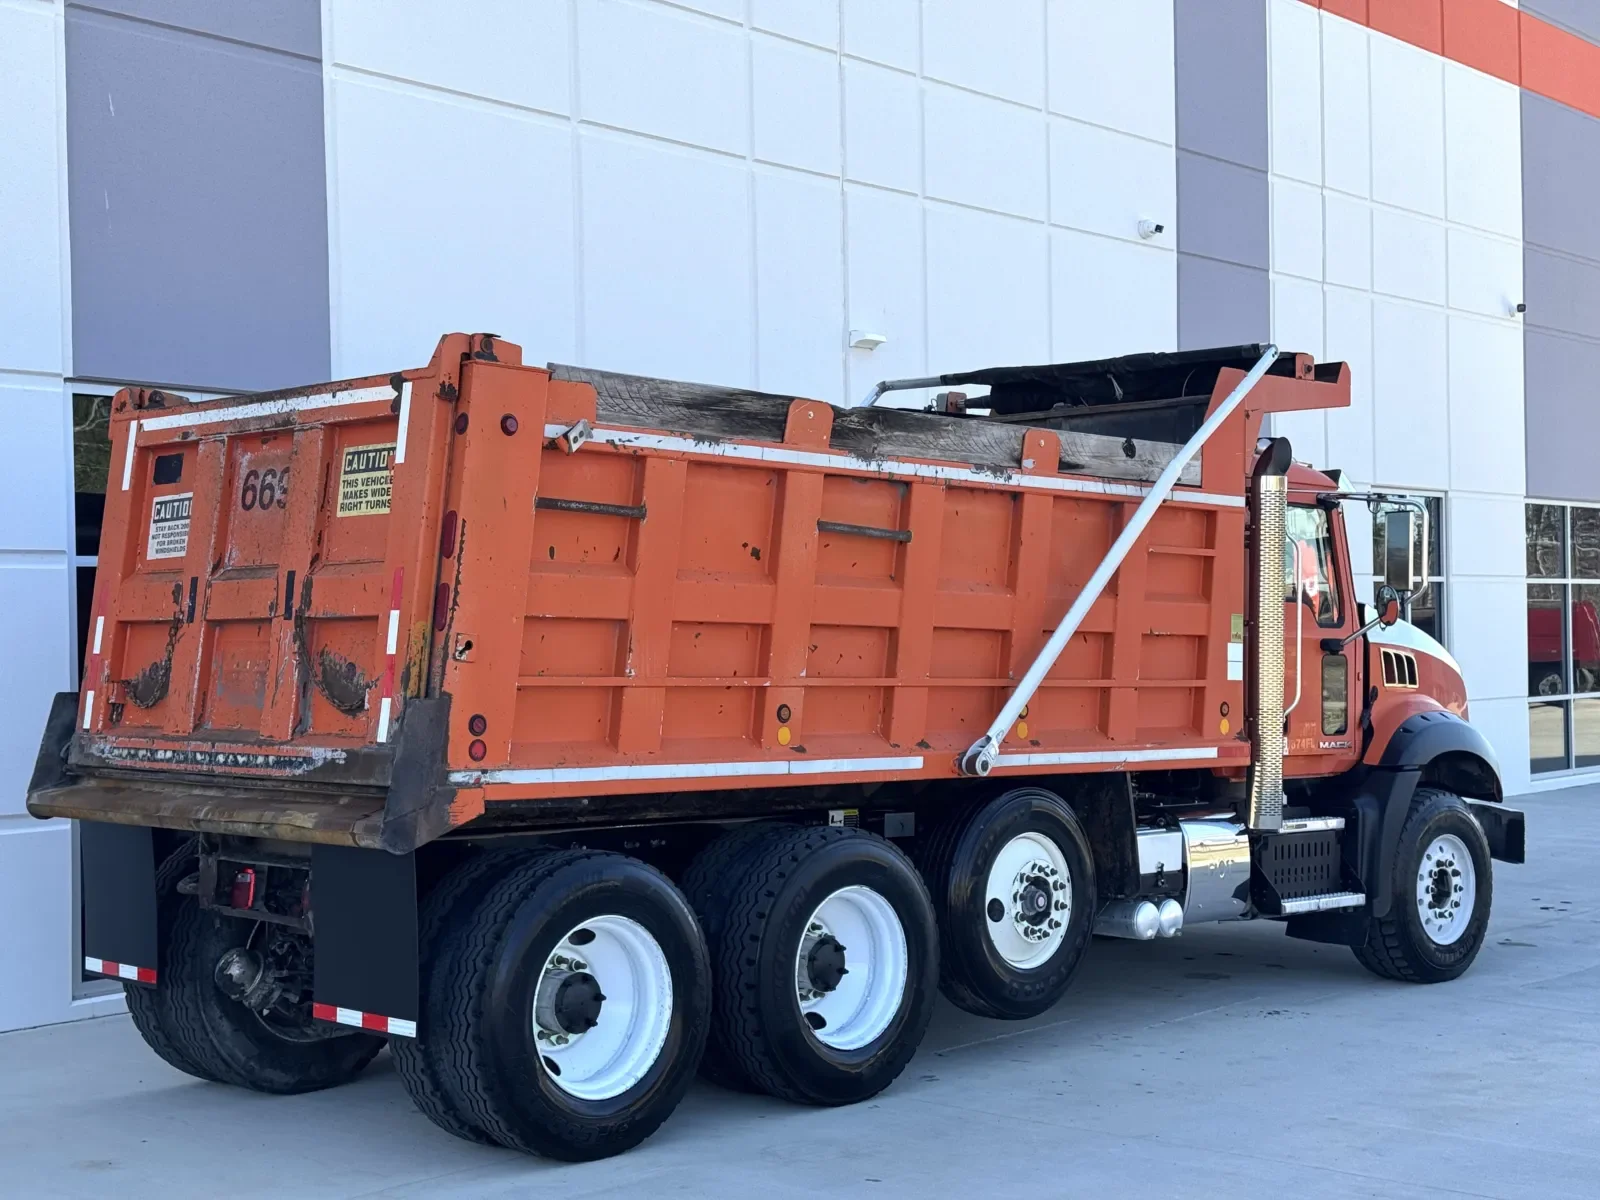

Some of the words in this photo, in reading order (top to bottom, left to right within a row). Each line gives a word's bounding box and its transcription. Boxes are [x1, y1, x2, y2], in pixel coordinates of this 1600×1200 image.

[342, 478, 359, 489] THIS
[342, 489, 369, 501] MAKES
[371, 487, 392, 498] WIDE
[340, 501, 364, 513] RIGHT
[365, 499, 392, 510] TURNS
[1319, 741, 1352, 749] MACK
